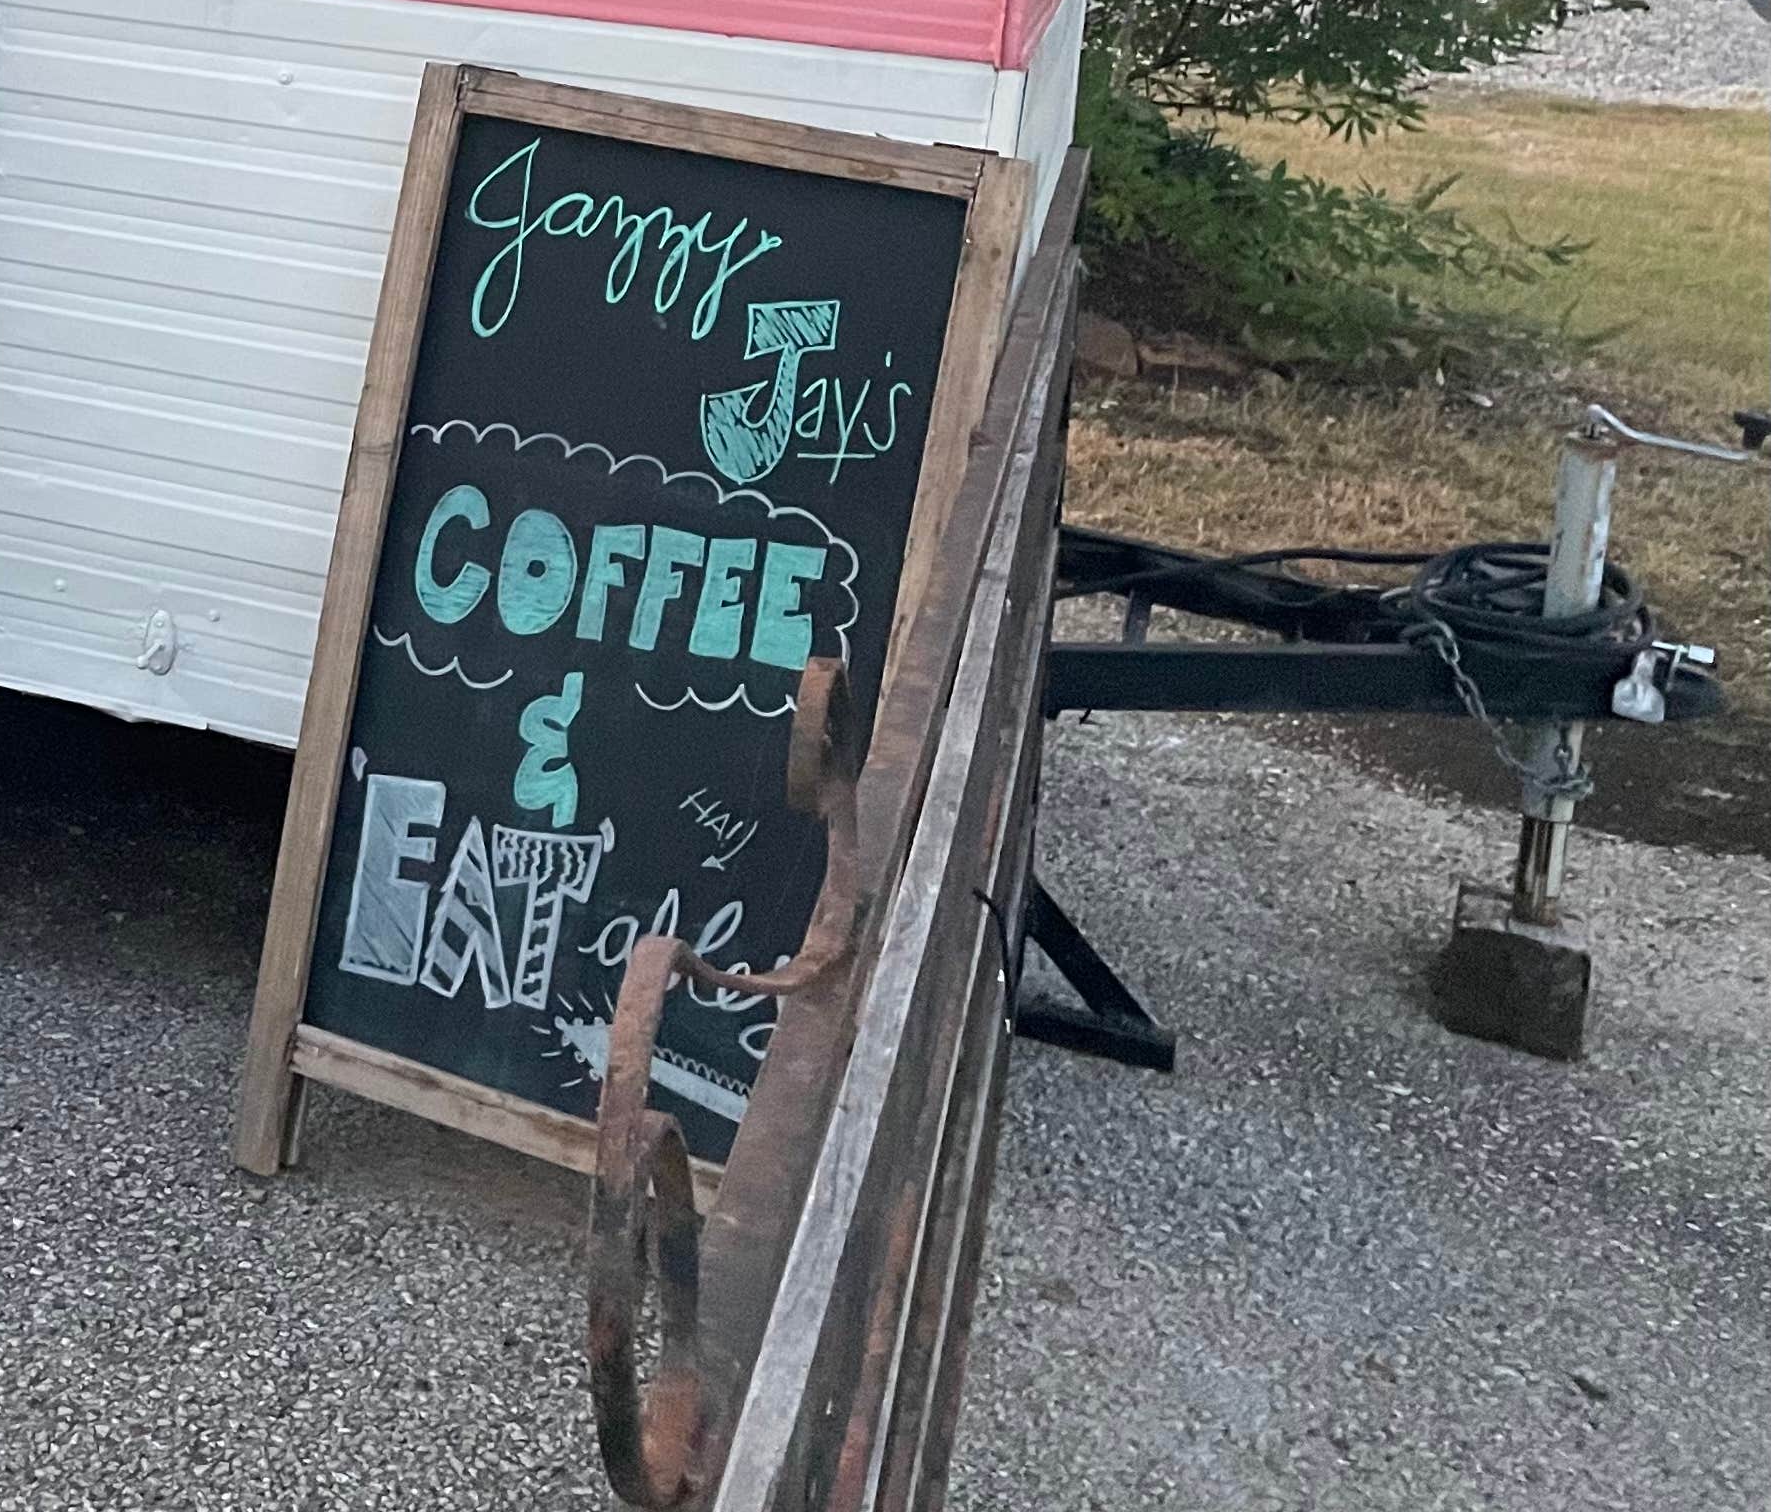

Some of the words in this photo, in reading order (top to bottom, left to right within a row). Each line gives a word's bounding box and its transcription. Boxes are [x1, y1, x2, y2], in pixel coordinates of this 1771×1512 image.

[466, 138, 782, 339] Jazzy
[700, 300, 912, 485] Jay's
[415, 485, 827, 670] COFFEE
[514, 671, 584, 828] &
[679, 787, 745, 849] HA!
